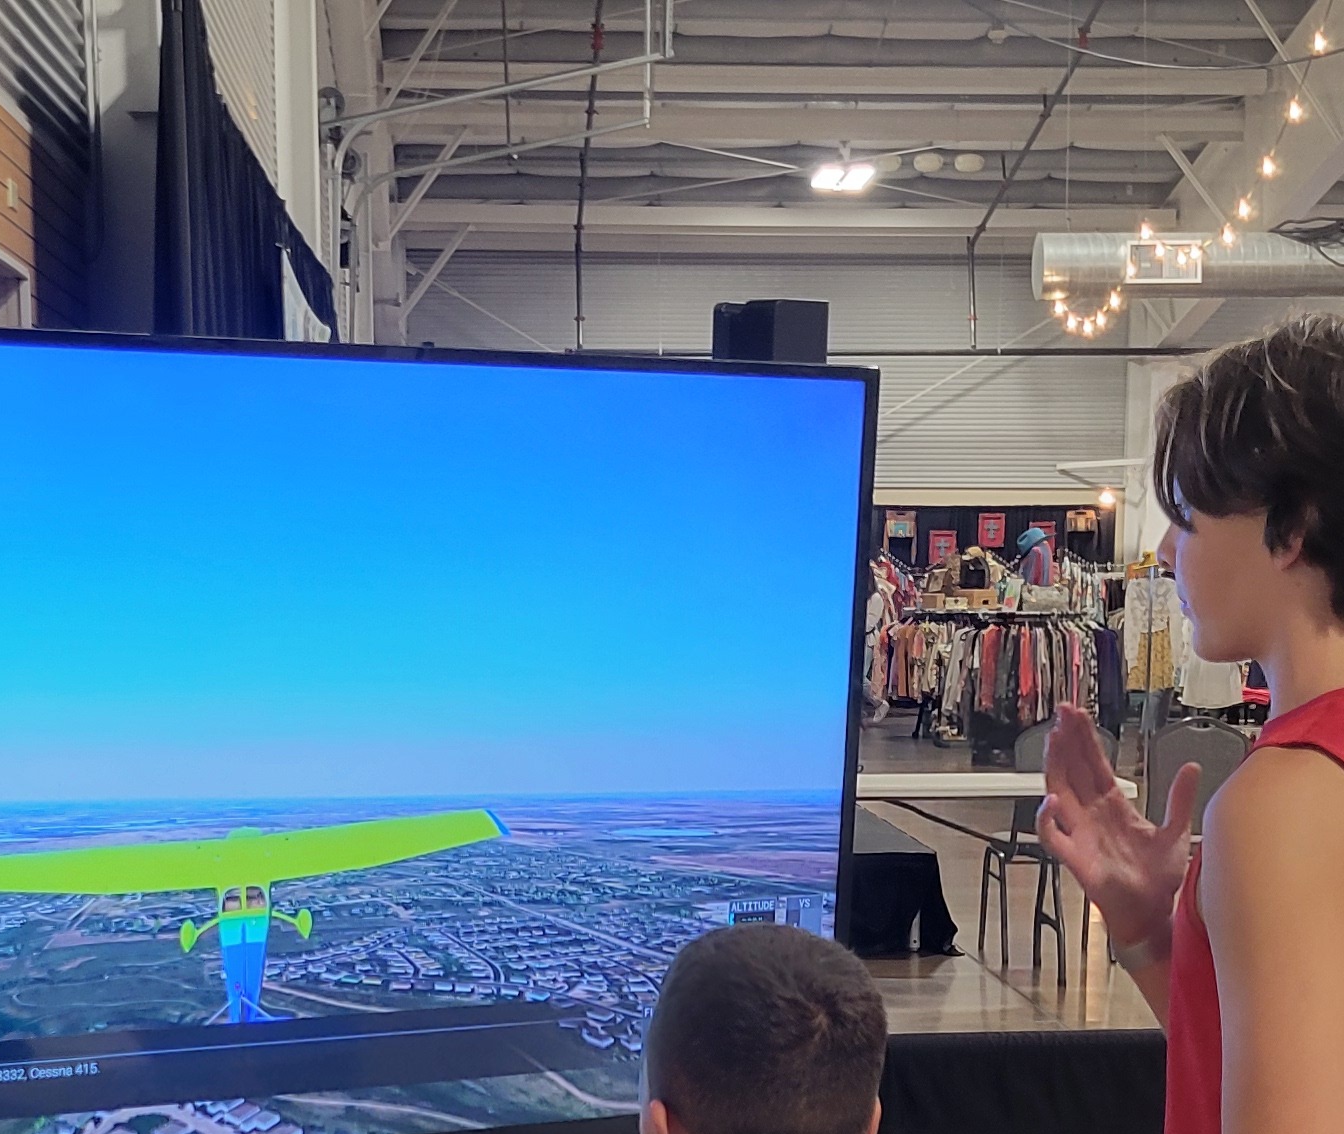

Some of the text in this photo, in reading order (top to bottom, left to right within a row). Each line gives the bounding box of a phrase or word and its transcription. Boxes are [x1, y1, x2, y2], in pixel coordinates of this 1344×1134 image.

[730, 900, 775, 912] ALTITUDE
[798, 898, 811, 908] VS
[30, 1065, 74, 1080] Cessna
[74, 1062, 101, 1076] 415.
